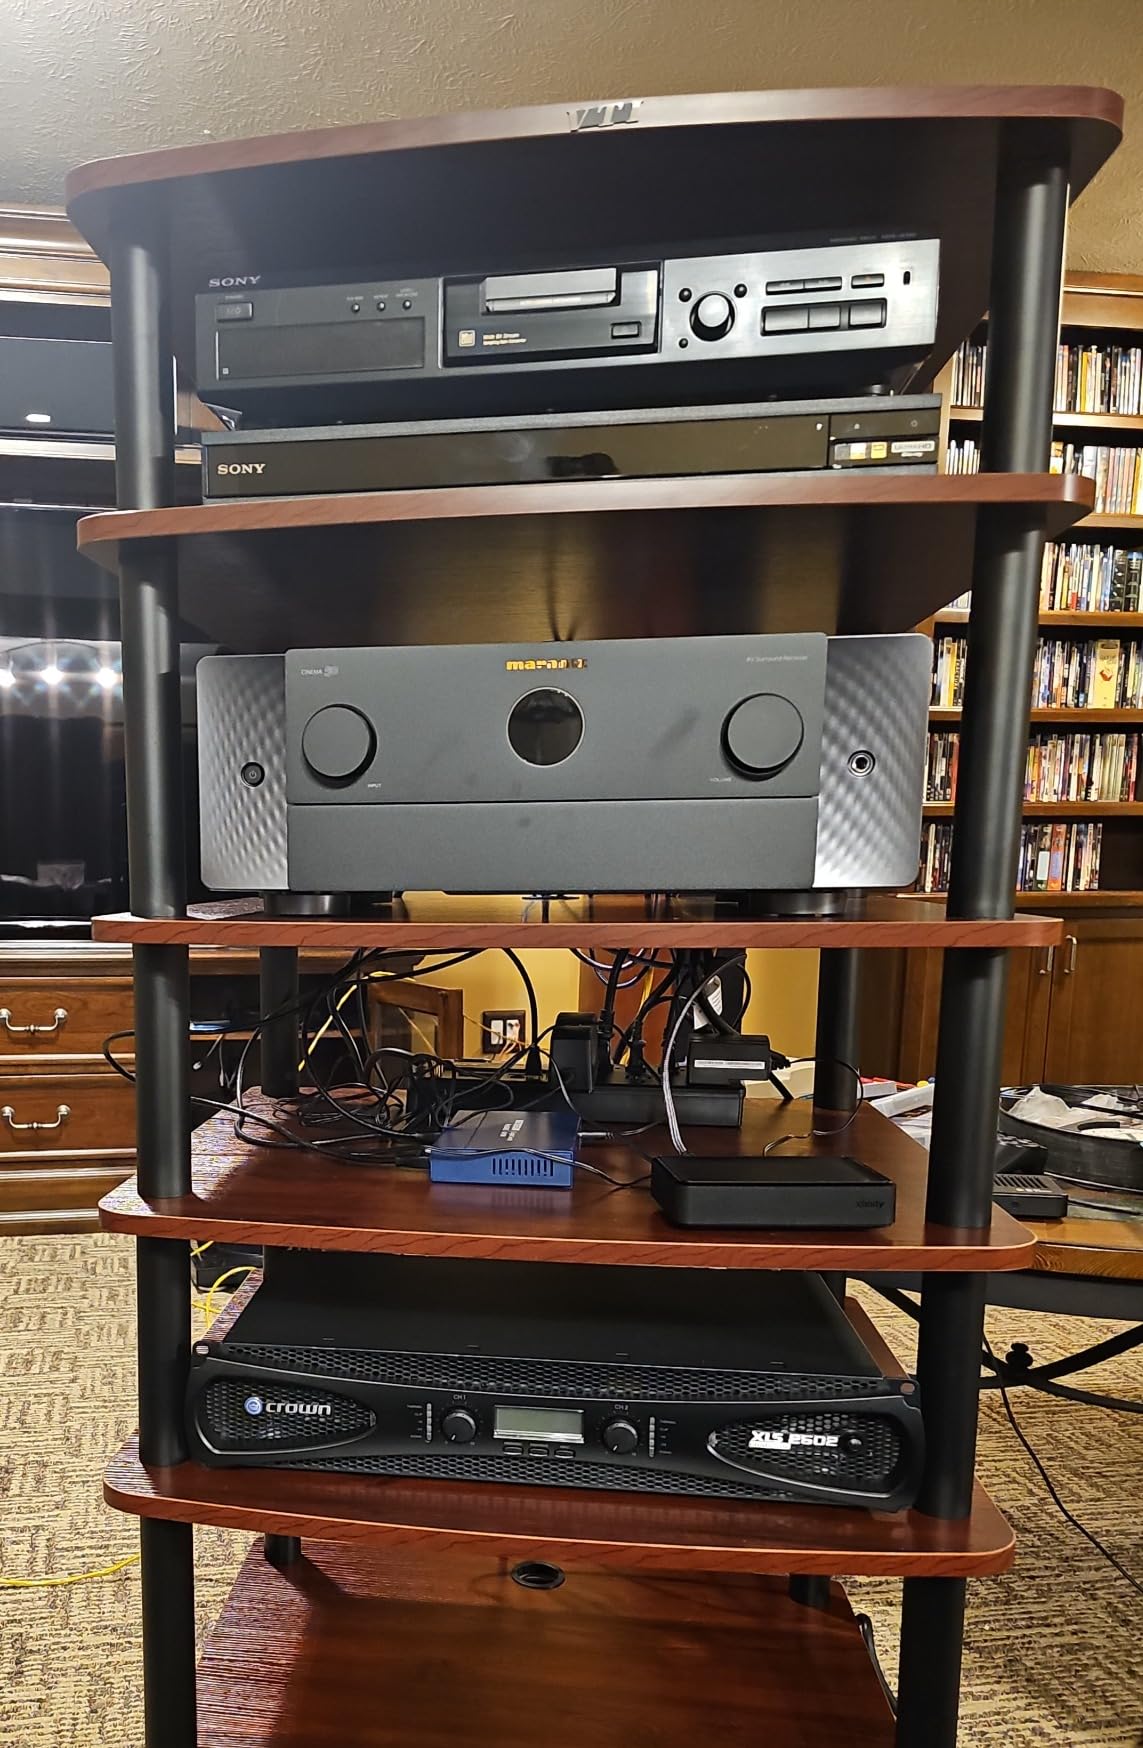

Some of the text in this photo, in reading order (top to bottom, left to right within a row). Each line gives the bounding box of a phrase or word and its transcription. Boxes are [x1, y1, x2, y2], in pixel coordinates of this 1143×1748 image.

[208, 275, 262, 288] SONY
[217, 463, 266, 475] SONY
[265, 1400, 332, 1416] crown
[751, 1430, 784, 1442] XLS
